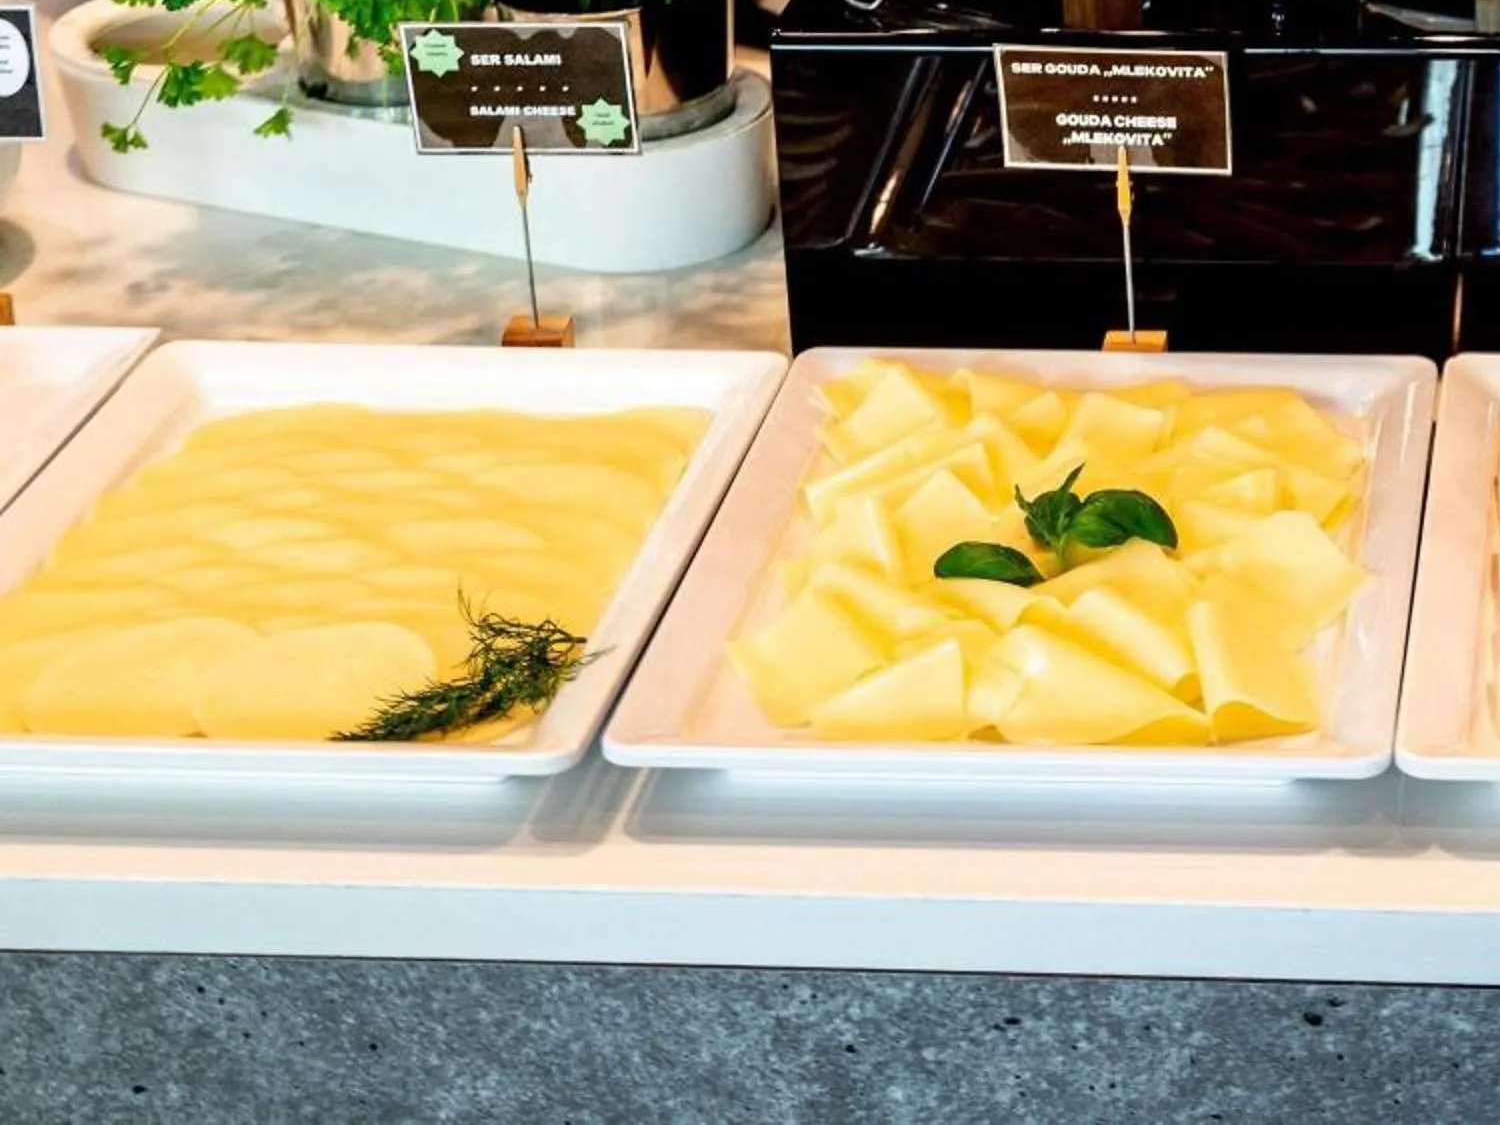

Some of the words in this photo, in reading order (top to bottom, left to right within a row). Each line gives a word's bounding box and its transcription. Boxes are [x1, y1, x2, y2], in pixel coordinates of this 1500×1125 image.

[470, 54, 501, 66] SER
[503, 54, 562, 66] SALAMI
[1011, 62, 1043, 74] SER
[1045, 62, 1100, 75] GOUDA
[469, 106, 520, 116] SALAMI
[523, 106, 576, 116] CHEESE
[1056, 113, 1112, 127] GOUDA
[1114, 114, 1177, 129] CHEESE
